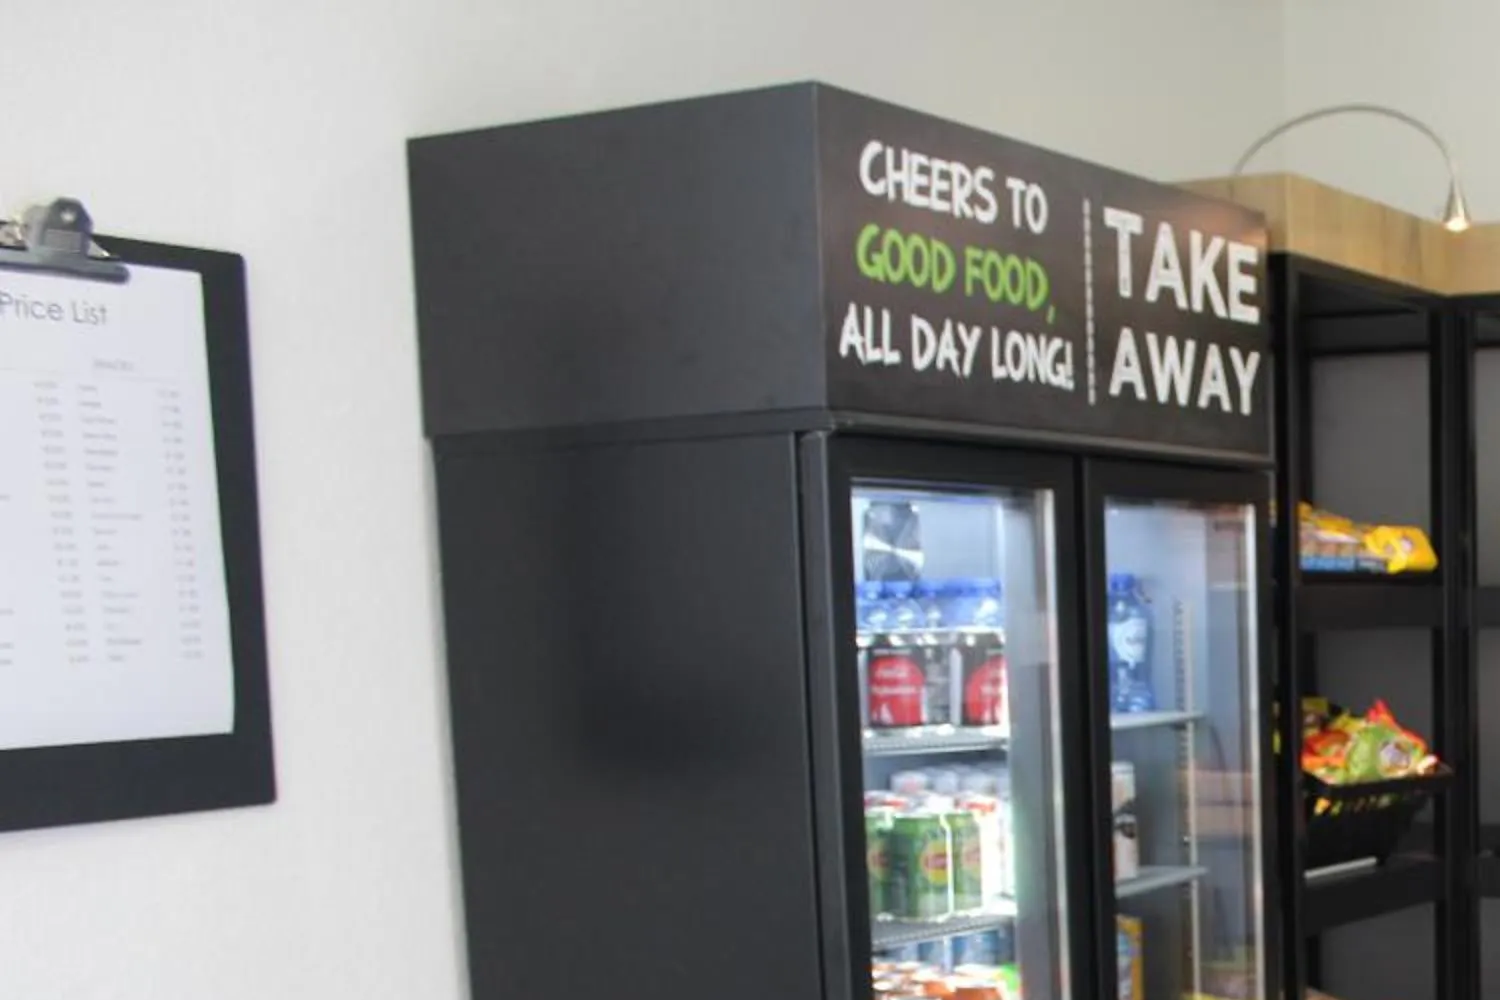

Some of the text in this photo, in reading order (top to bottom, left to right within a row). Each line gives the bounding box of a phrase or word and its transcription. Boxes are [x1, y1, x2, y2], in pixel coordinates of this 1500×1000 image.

[859, 141, 1049, 234] CHEERS TO
[856, 224, 1056, 324] GOOD FOOD,
[1104, 207, 1260, 325] TAKE
[71, 299, 107, 325] List
[839, 303, 1075, 392] ALL DAY LONG!
[1109, 327, 1260, 416] AWAY
